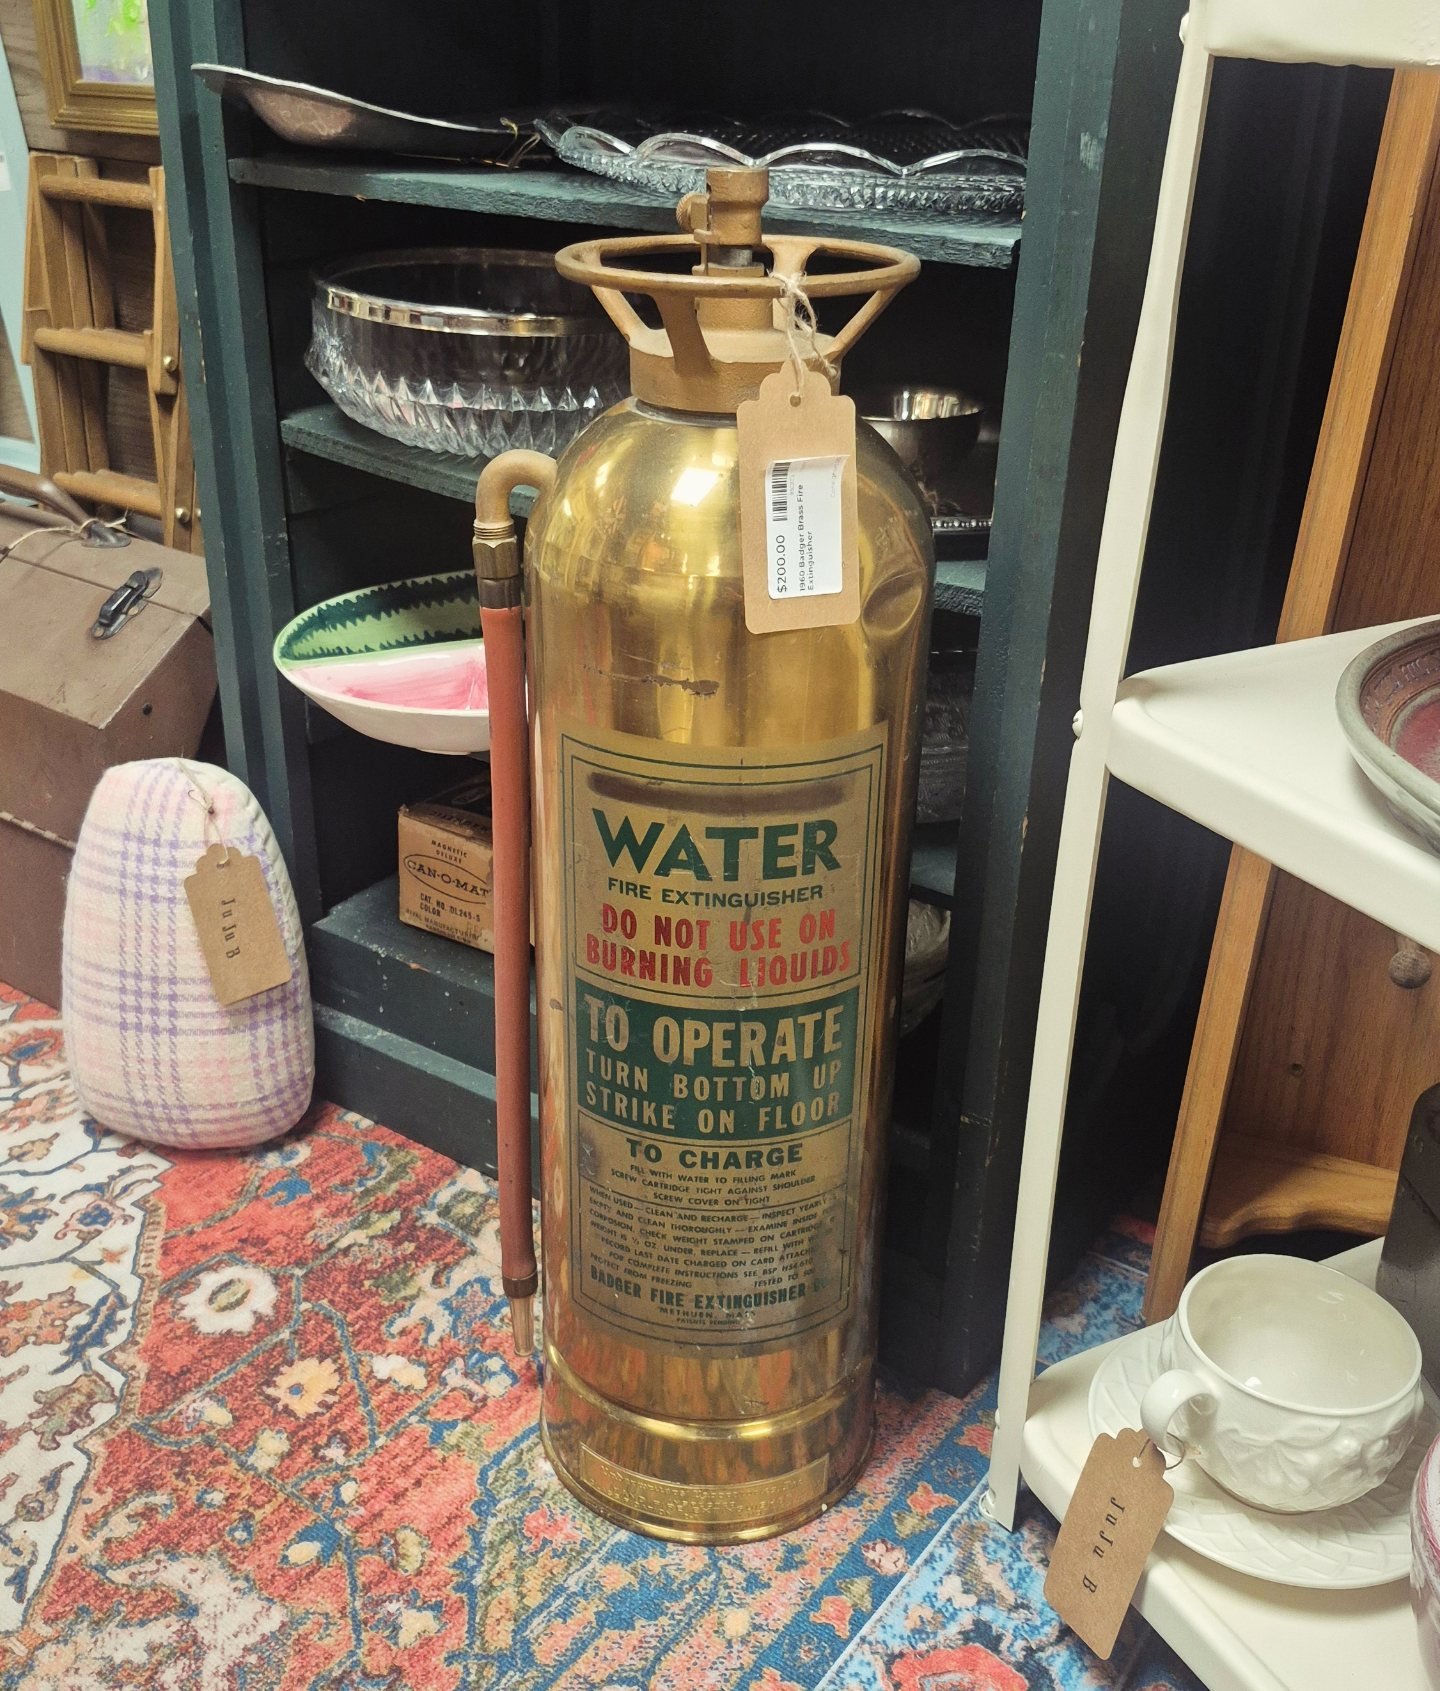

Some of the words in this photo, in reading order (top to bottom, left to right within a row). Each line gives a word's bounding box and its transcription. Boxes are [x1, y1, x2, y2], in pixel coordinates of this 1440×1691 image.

[796, 484, 804, 503] Fire
[797, 506, 805, 531] Brass
[775, 534, 788, 593] $200.00
[798, 534, 807, 568] Badger
[807, 531, 815, 591] Extinguisher
[431, 839, 467, 858] MAGNETIC
[592, 807, 842, 882] WATER
[608, 876, 652, 901] FIRE
[661, 884, 824, 908] EXTINGUISHER
[420, 902, 441, 917] COLOR
[602, 902, 637, 940] DO
[654, 914, 711, 950] NOT
[729, 917, 782, 951] USE
[799, 908, 836, 945] ON
[586, 932, 713, 988] BURNING
[739, 938, 851, 988] LIQUIDS
[584, 993, 629, 1052] TO
[653, 1004, 845, 1068] OPERATE
[586, 1047, 649, 1093] TURN
[673, 1072, 790, 1102] BOTTOM
[812, 1059, 842, 1090] UP
[586, 1080, 676, 1130] STRIKE
[697, 1108, 735, 1134] ON
[758, 1090, 841, 1132] FLOOR
[626, 1138, 663, 1164] TO
[678, 1142, 804, 1170] CHARGE
[610, 1168, 638, 1183] SCREW
[641, 1179, 690, 1193] CARTRIDGE
[696, 1187, 722, 1195] TIGHT
[727, 1185, 768, 1195] AGAINST
[772, 1175, 816, 1191] SHOULDER
[630, 1164, 645, 1174] FILL
[649, 1168, 673, 1180] WITH
[677, 1174, 709, 1183] WATER
[715, 1176, 728, 1184] TO
[732, 1175, 766, 1184] FILLING
[770, 1169, 797, 1180] MARK
[613, 1196, 634, 1209] USED
[645, 1207, 673, 1219] CLEAN
[676, 1213, 698, 1221] AND
[700, 1215, 749, 1223] RECHARGE
[761, 1207, 796, 1219] INSPECT
[652, 1192, 683, 1203] SCREW
[688, 1197, 719, 1206] COVER
[724, 1198, 740, 1206] ON
[744, 1195, 770, 1205] TIGHT
[616, 1208, 634, 1221] AND
[637, 1216, 666, 1229] CLEAN
[670, 1223, 732, 1234] THOROUGHLY
[747, 1220, 788, 1233] EXAMINE
[639, 1228, 667, 1240] CHECK
[672, 1235, 708, 1245] WEIGHT
[713, 1236, 755, 1246] STAMPED
[759, 1234, 775, 1243] ON
[700, 1248, 738, 1257] REPLACE
[753, 1245, 779, 1255] REFILL
[782, 1239, 804, 1251] WITH
[627, 1258, 671, 1274] COMPLETE
[674, 1269, 739, 1279] INSTRUCTIONS
[743, 1269, 758, 1278] SEE
[634, 1248, 653, 1259] LAST
[657, 1254, 680, 1265] DATE
[683, 1259, 727, 1268] CHARGED
[731, 1260, 747, 1268] ON
[750, 1256, 775, 1266] CARD
[591, 1264, 641, 1299] BADGER
[650, 1287, 684, 1308] FIRE
[694, 1282, 806, 1311] EXTINGUISHER
[623, 1267, 647, 1280] FROM
[651, 1275, 693, 1289] FREEZING
[754, 1277, 783, 1288] TESTED
[787, 1273, 799, 1281] TO
